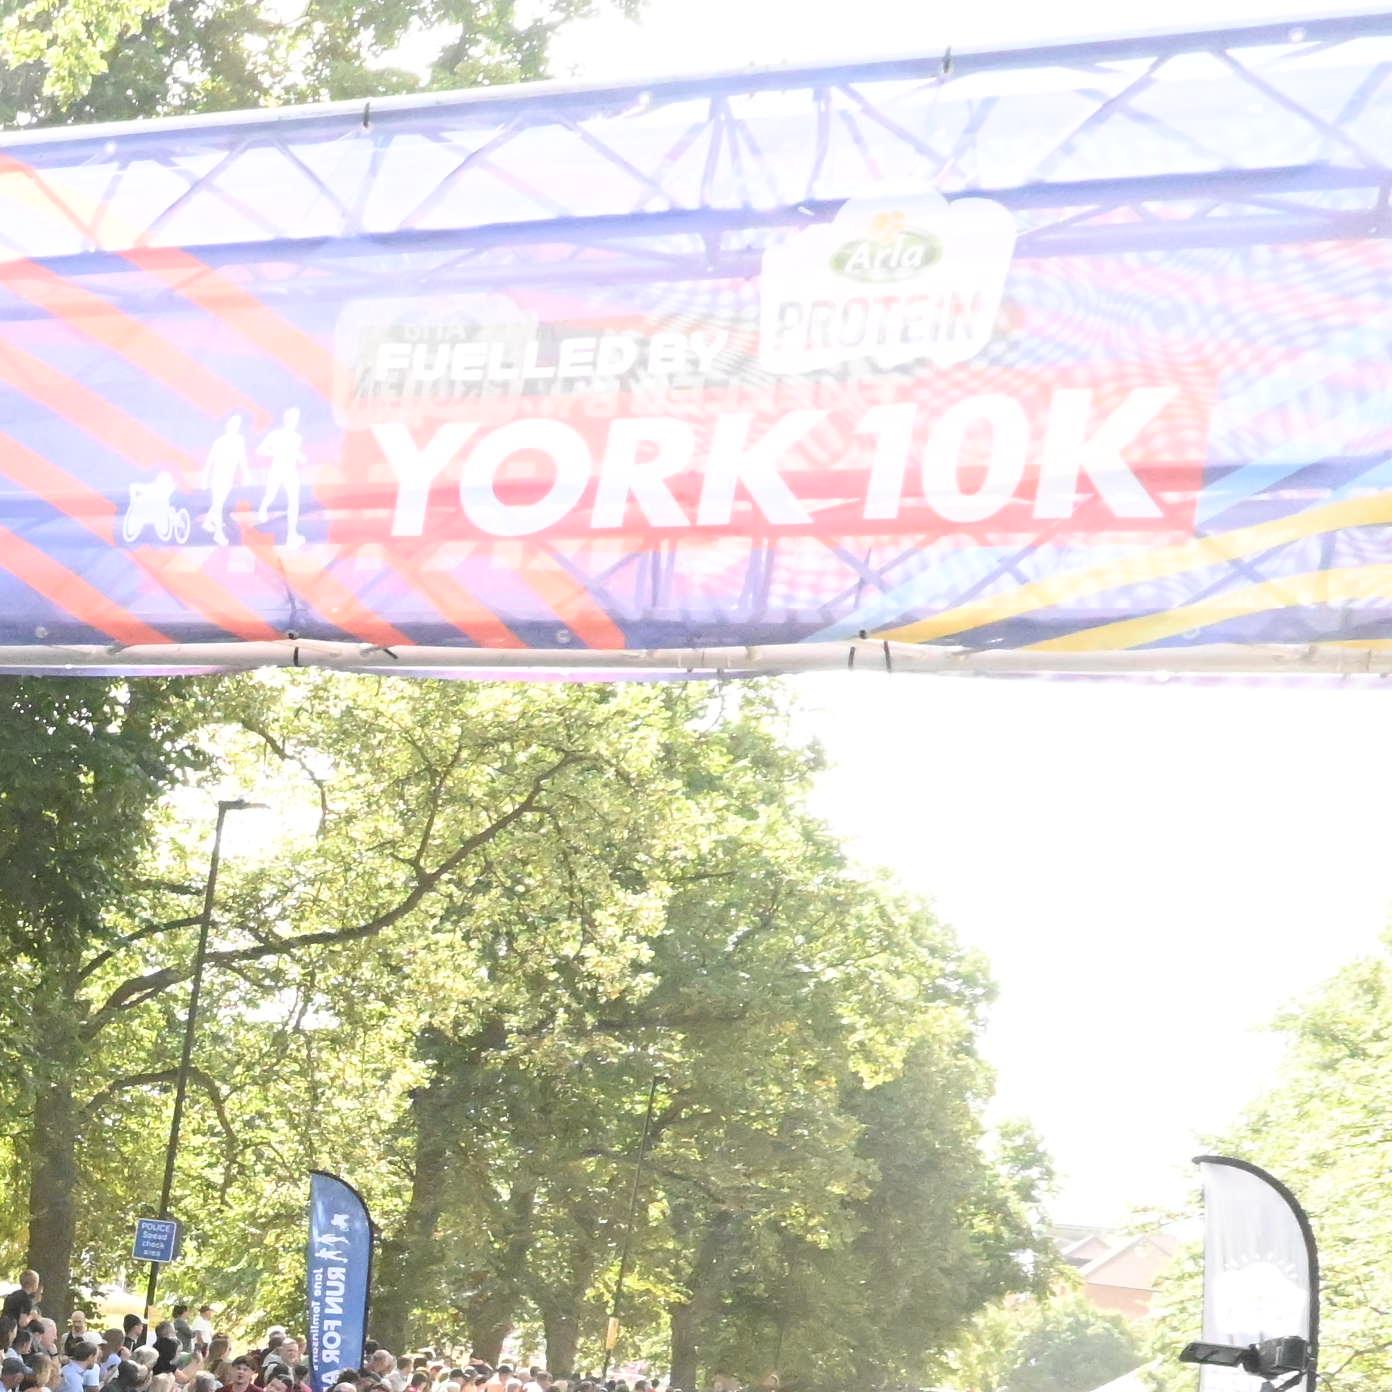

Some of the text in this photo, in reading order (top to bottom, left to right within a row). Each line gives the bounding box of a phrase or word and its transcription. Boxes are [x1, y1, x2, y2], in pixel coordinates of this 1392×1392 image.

[842, 233, 927, 274] Arla
[778, 290, 982, 352] PROTEIN
[373, 328, 730, 382] FUELLED BY
[370, 385, 1179, 538] YORK 10K
[141, 1222, 171, 1233] POLICE
